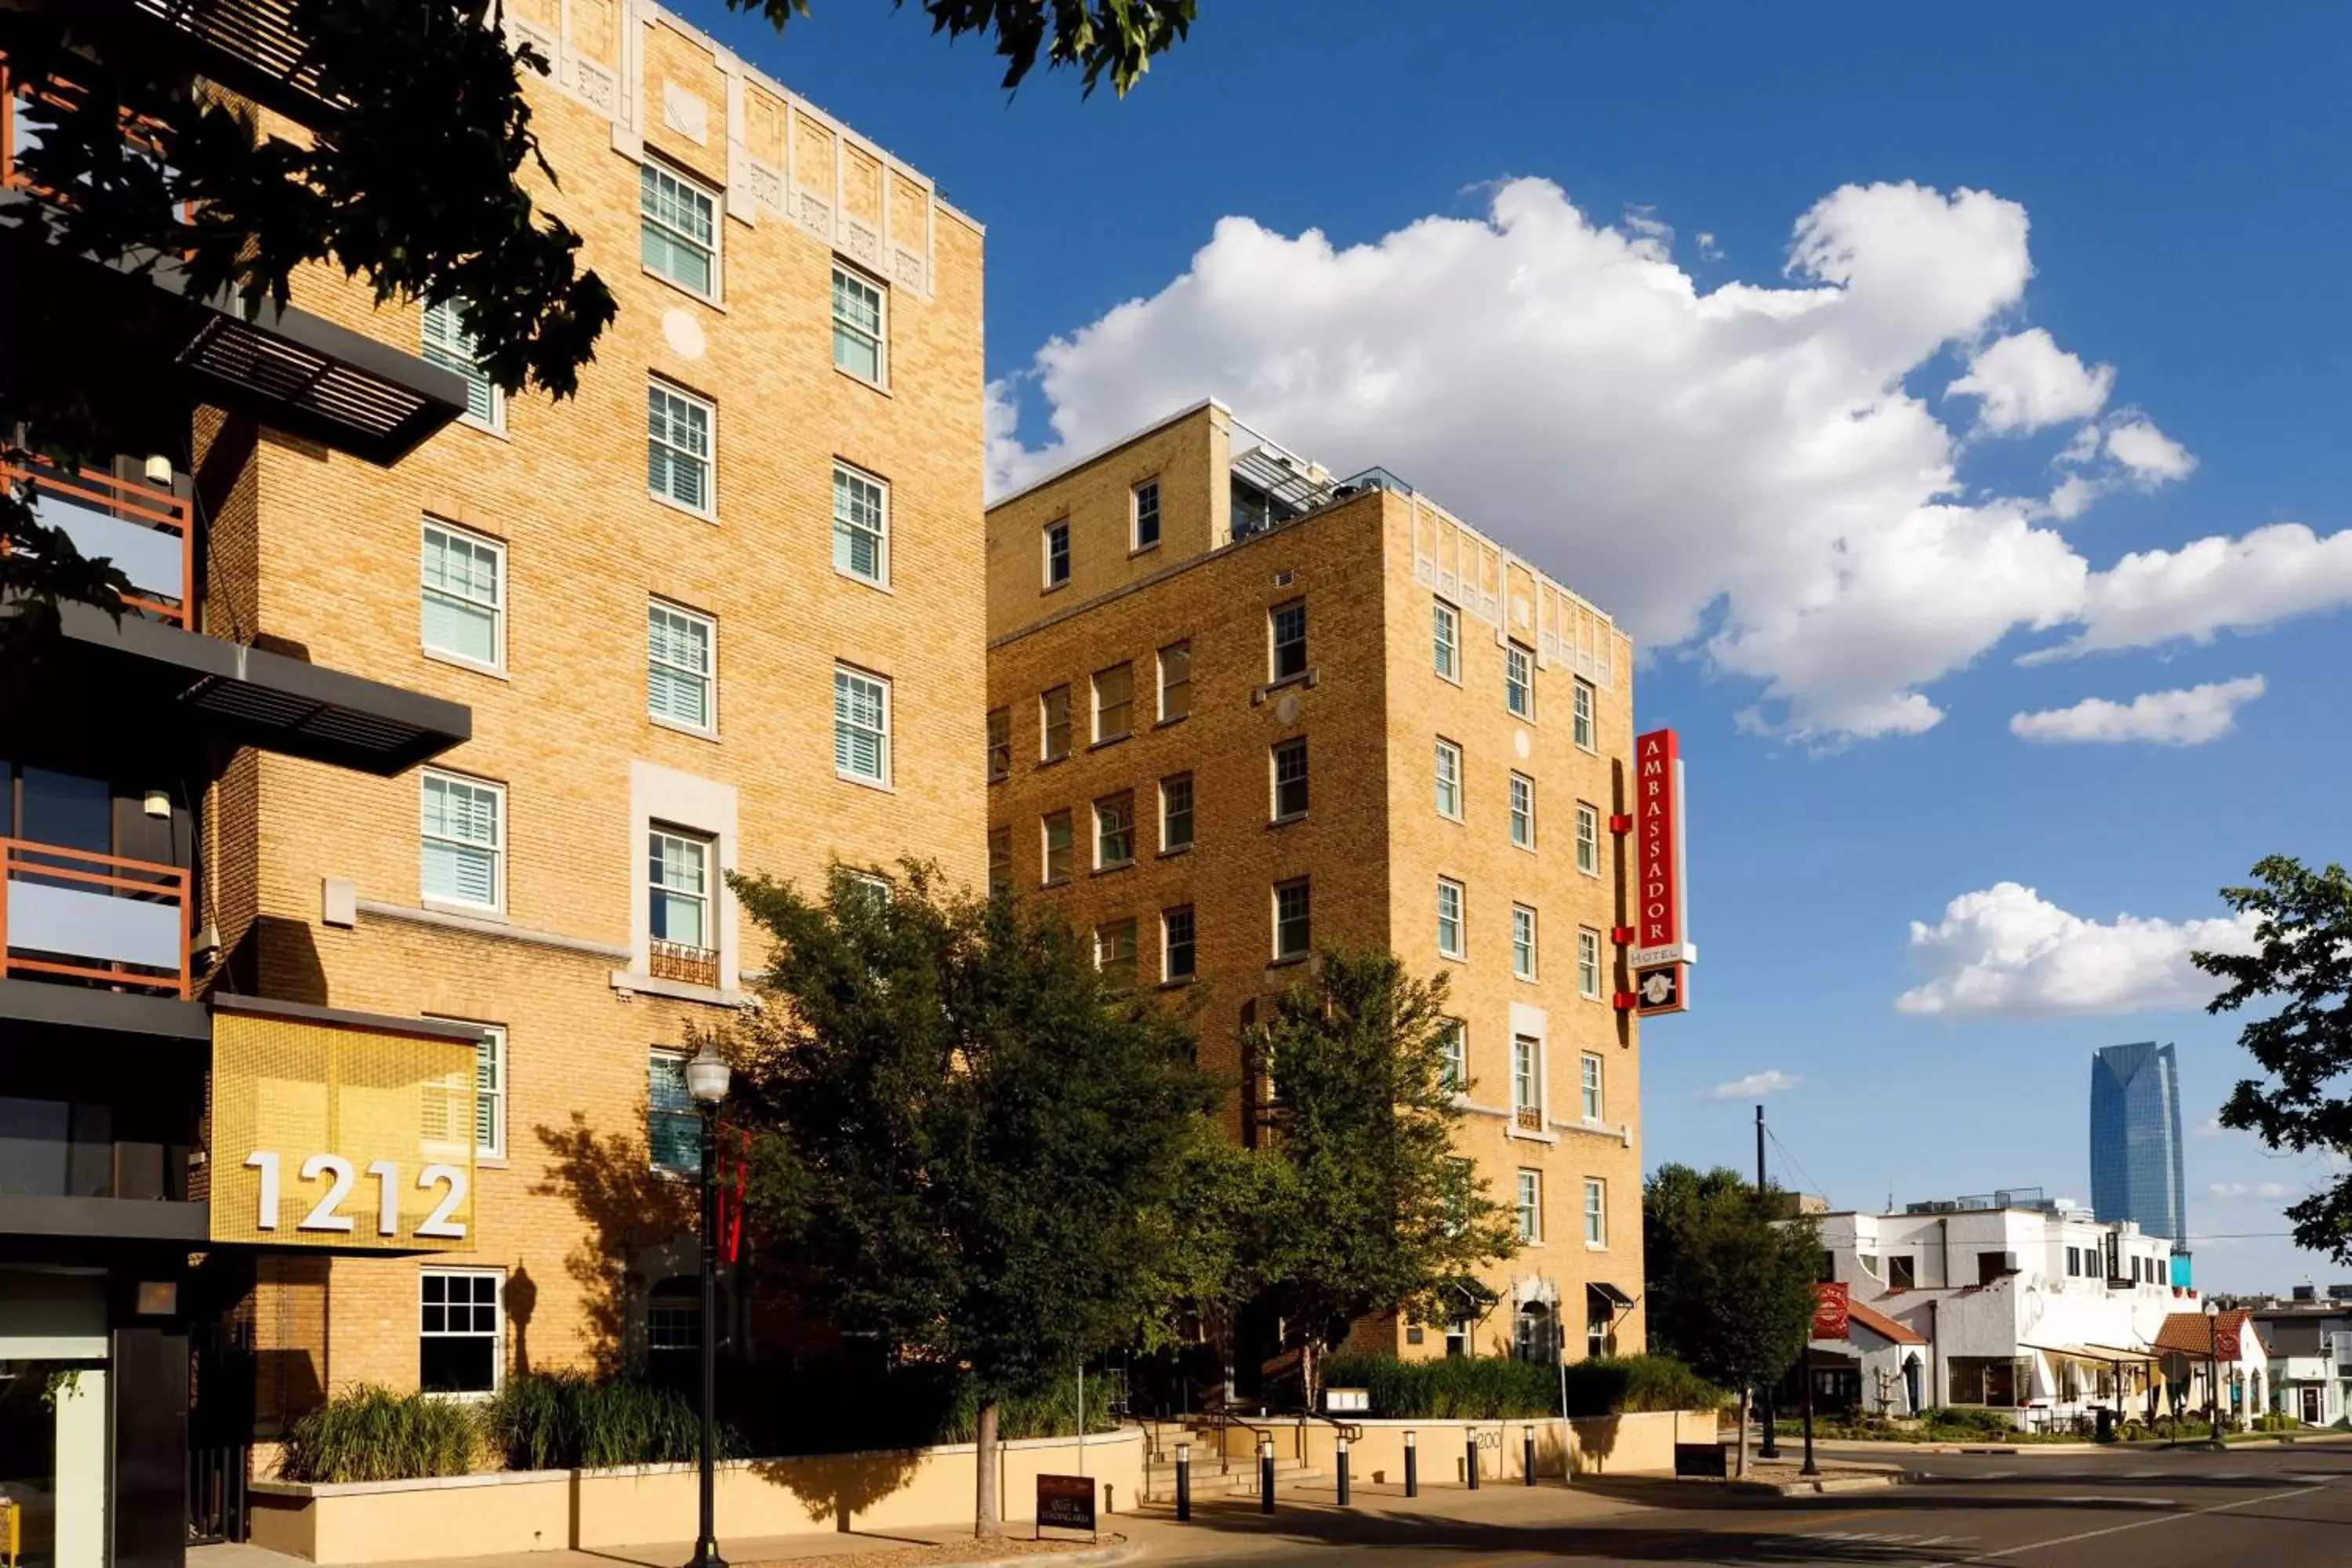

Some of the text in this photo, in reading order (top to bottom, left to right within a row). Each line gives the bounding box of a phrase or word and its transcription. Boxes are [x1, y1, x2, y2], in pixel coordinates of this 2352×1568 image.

[1642, 739, 1664, 939] AMBASSADOR
[1630, 949, 1678, 964] HOTEL
[243, 1151, 469, 1239] 1212
